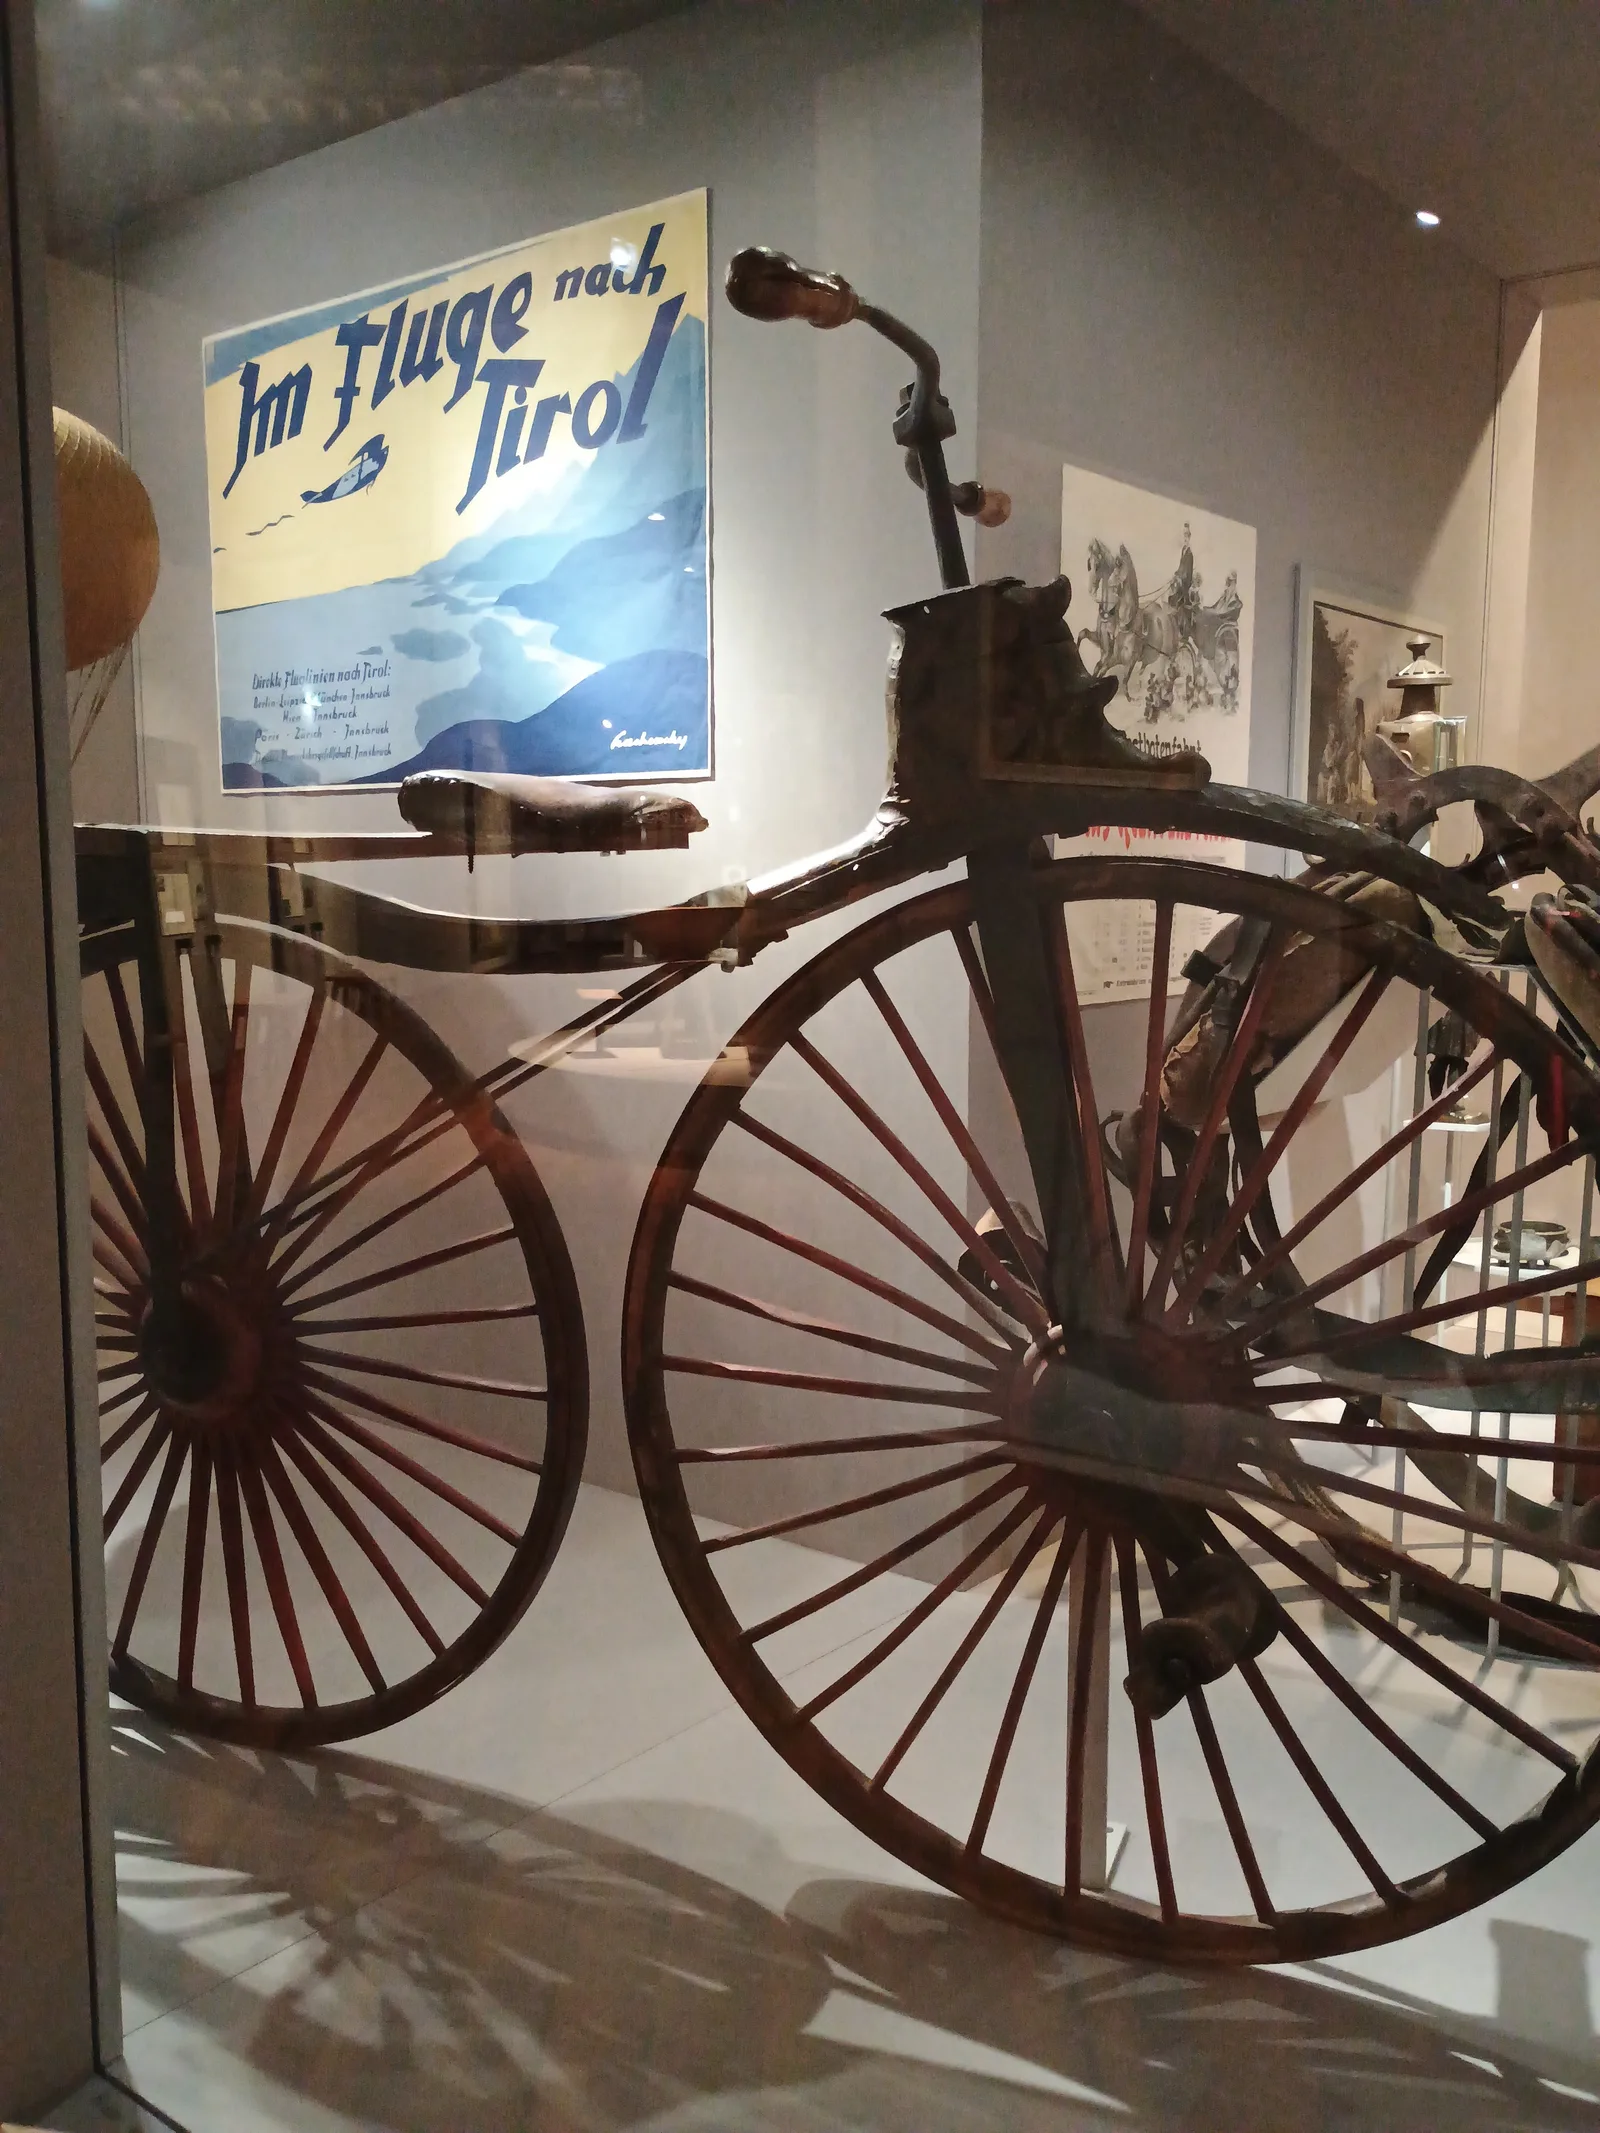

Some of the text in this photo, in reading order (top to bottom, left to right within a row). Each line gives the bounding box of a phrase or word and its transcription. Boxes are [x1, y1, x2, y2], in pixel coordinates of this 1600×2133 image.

[323, 271, 532, 452] Fluge
[553, 222, 667, 301] nach
[455, 291, 687, 516] Tirol
[337, 663, 361, 682] nach
